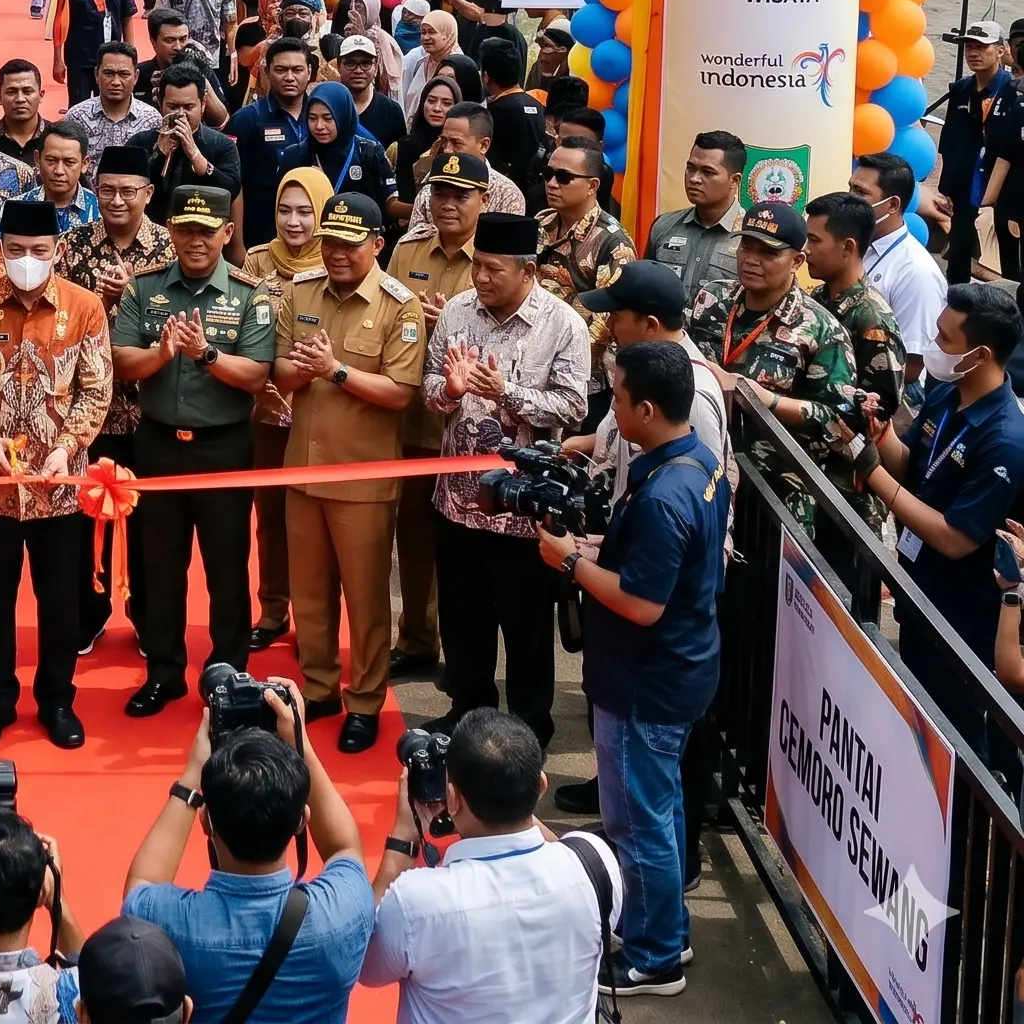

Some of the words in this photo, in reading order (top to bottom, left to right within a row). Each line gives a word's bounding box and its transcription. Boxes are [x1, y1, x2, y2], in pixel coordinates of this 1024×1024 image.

[700, 53, 784, 68] wonderful
[700, 68, 806, 88] indonesia
[819, 686, 883, 824] PANTAI
[778, 697, 844, 844] CEMORO
[847, 804, 929, 973] SEWANG
